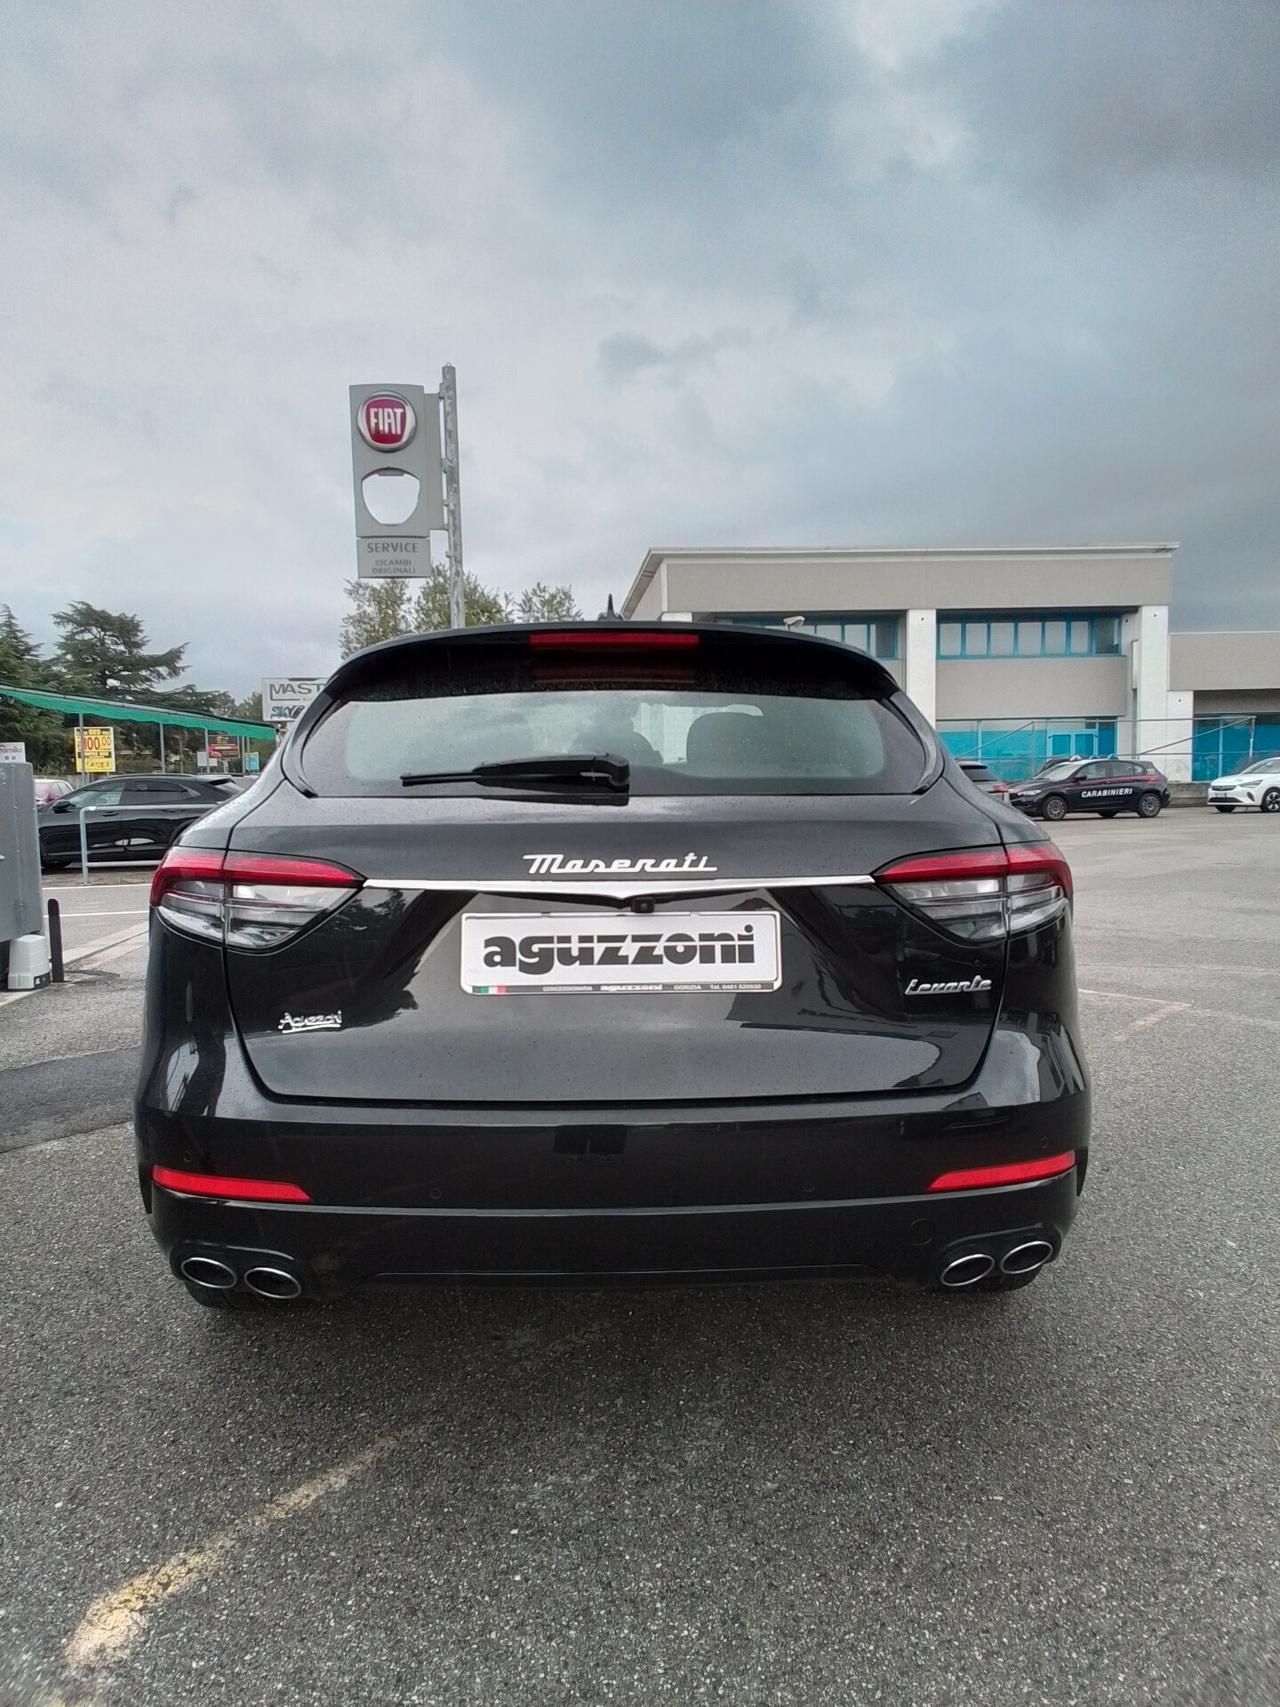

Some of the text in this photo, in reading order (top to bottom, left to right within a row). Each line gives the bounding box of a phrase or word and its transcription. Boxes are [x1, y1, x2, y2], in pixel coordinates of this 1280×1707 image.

[369, 407, 404, 434] FIAT
[367, 541, 419, 553] SERVICE
[1081, 787, 1133, 798] CARABINIERI
[522, 852, 718, 874] Maserati
[483, 924, 755, 976] aguzzoni
[904, 974, 992, 995] Levante
